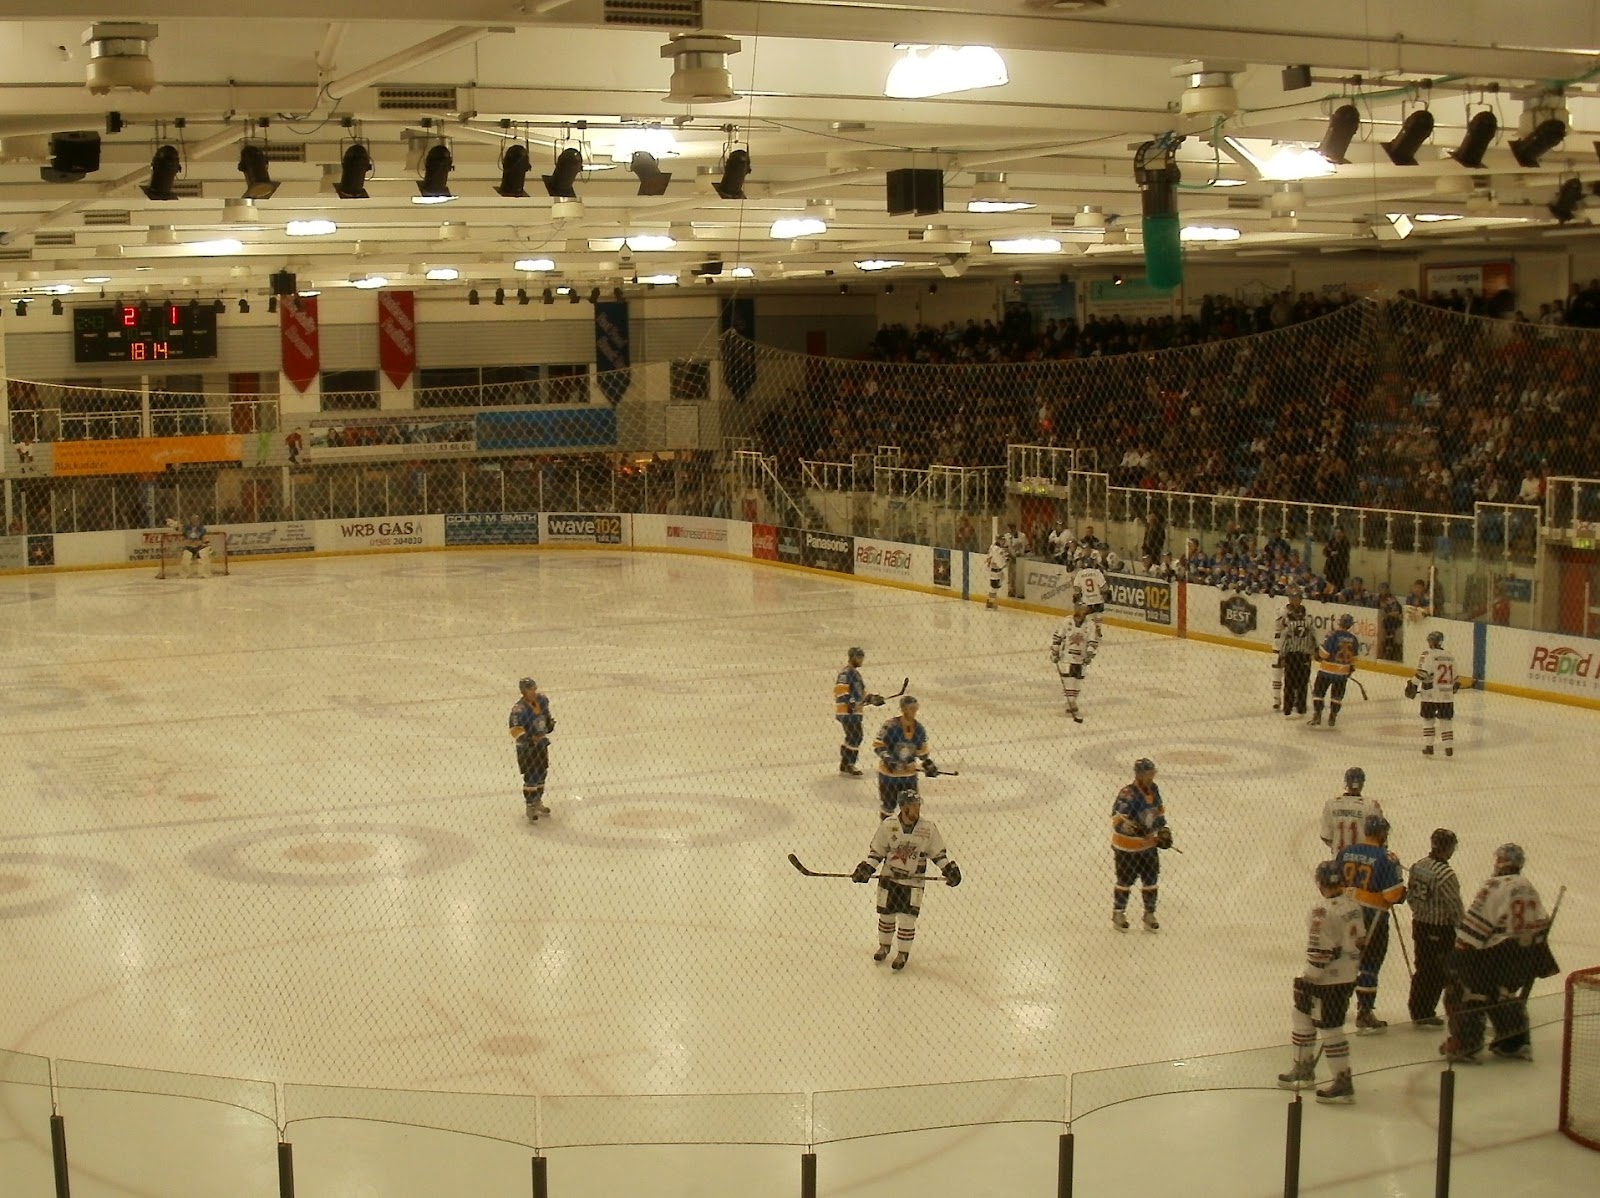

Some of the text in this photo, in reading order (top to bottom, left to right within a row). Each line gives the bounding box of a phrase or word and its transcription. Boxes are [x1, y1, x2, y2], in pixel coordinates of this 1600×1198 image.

[123, 307, 135, 325] 2
[171, 306, 177, 324] 1
[131, 341, 168, 360] 18 14
[446, 513, 538, 523] COLIN M SMITH
[549, 518, 620, 534] wave102
[341, 521, 414, 539] WRB GAS
[806, 533, 849, 553] Panasonic
[857, 546, 912, 569] Rapid Rapid
[1027, 572, 1060, 588] CCS
[1085, 578, 1095, 593] 9
[1226, 608, 1251, 623] BEST
[1530, 646, 1593, 677] Rapid
[1437, 664, 1453, 684] 21
